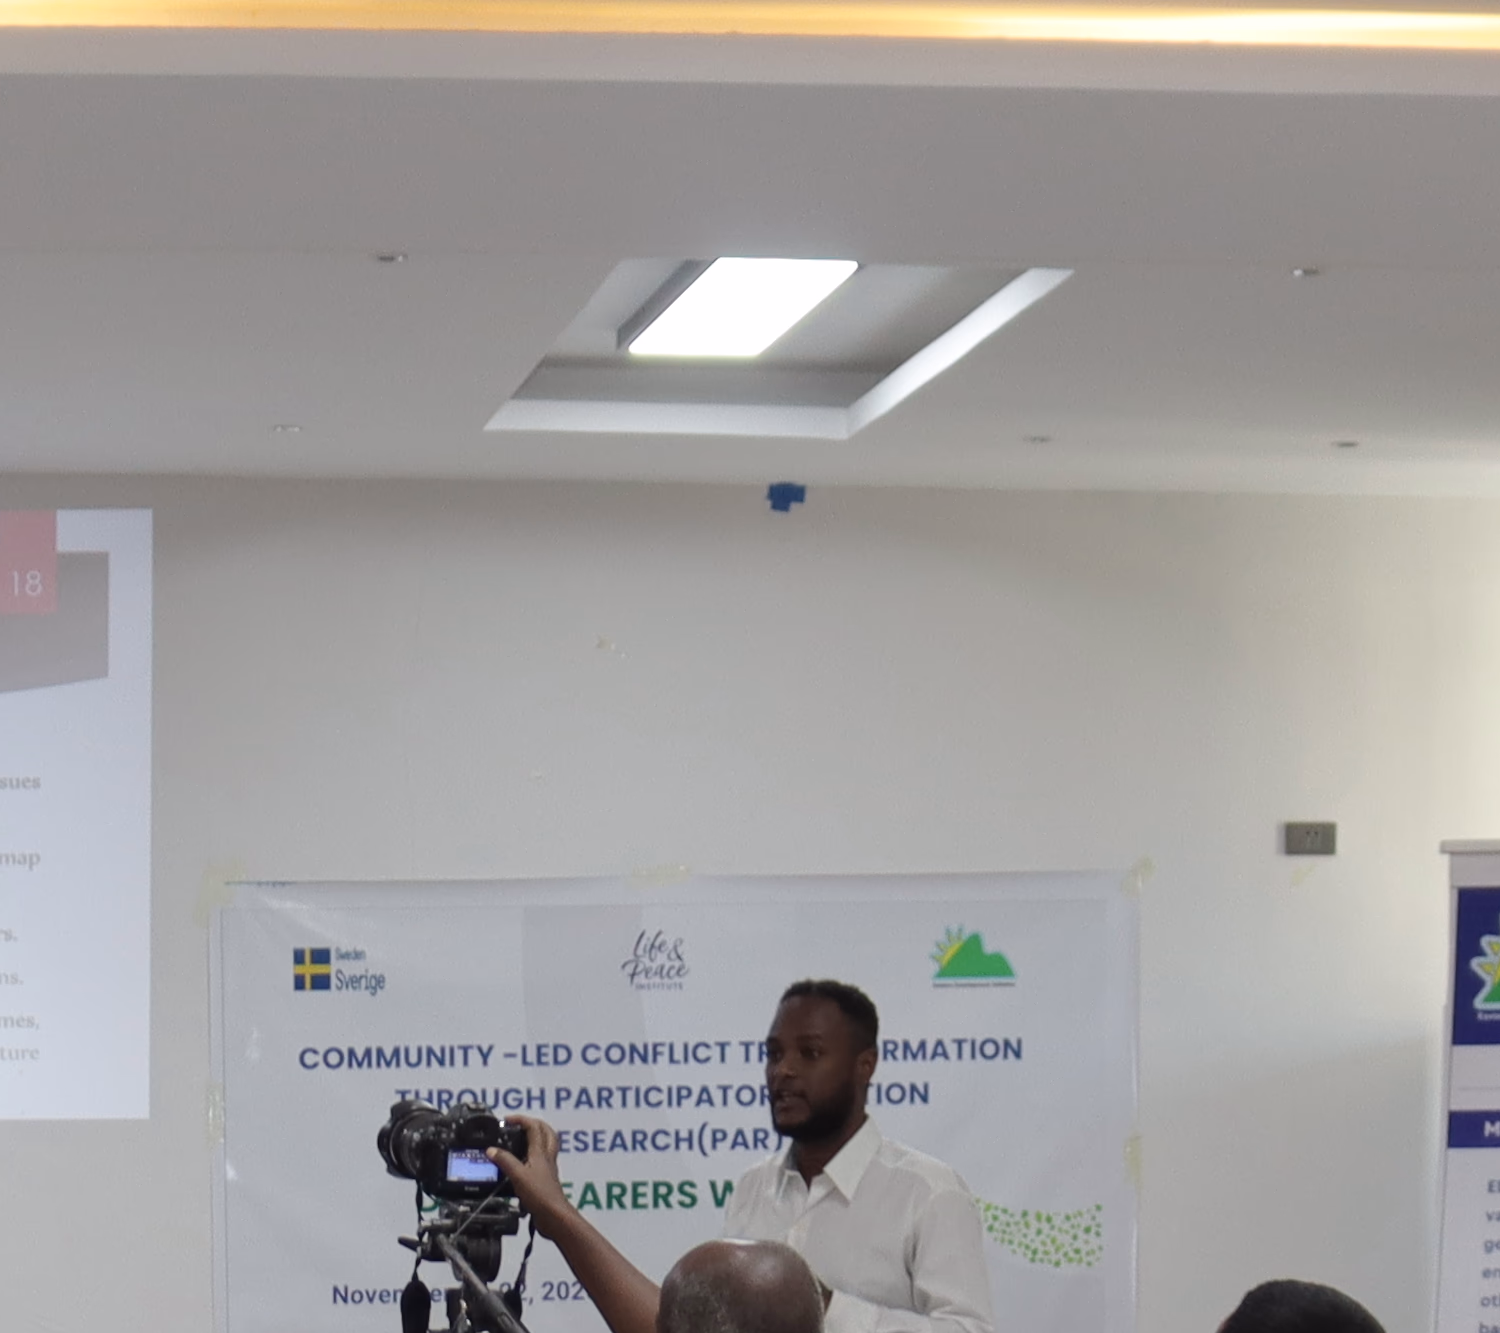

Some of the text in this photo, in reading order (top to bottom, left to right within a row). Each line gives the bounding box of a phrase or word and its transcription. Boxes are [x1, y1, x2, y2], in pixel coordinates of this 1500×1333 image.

[13, 569, 43, 597] 18
[335, 947, 366, 961] Sweden
[633, 928, 684, 963] Life &
[335, 968, 386, 996] Sverige
[621, 958, 690, 986] Peace
[299, 1044, 495, 1070] COMMUNITY
[581, 1041, 732, 1066] CONFLICT
[555, 1084, 771, 1110] PARTICIPATOR
[557, 1121, 784, 1157] ESEARCH(PAR)
